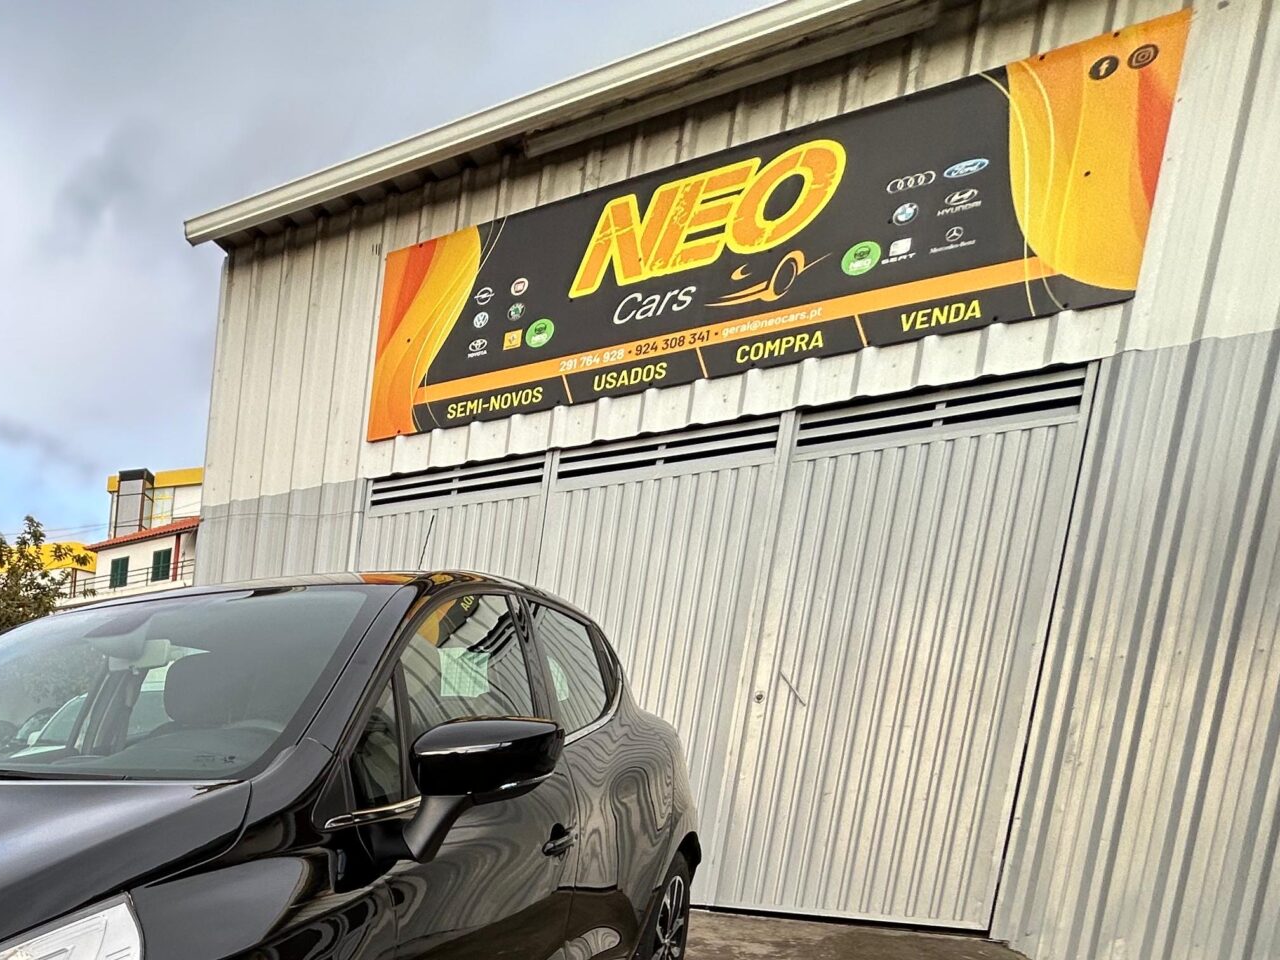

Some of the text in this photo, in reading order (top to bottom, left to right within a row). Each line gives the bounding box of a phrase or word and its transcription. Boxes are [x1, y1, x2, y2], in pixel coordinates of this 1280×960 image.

[951, 160, 980, 175] Ford
[568, 139, 846, 298] NEO
[936, 200, 982, 216] HYUNDAI
[881, 252, 917, 265] SEAT
[613, 284, 697, 325] Cars
[900, 300, 982, 332] VENDA
[559, 307, 823, 373] 291 764 928 924 308 341 geral@neocars.pt
[735, 330, 825, 364] COMPRA
[593, 362, 668, 392] USADOS
[446, 386, 544, 420] SEMI-NOVOS
